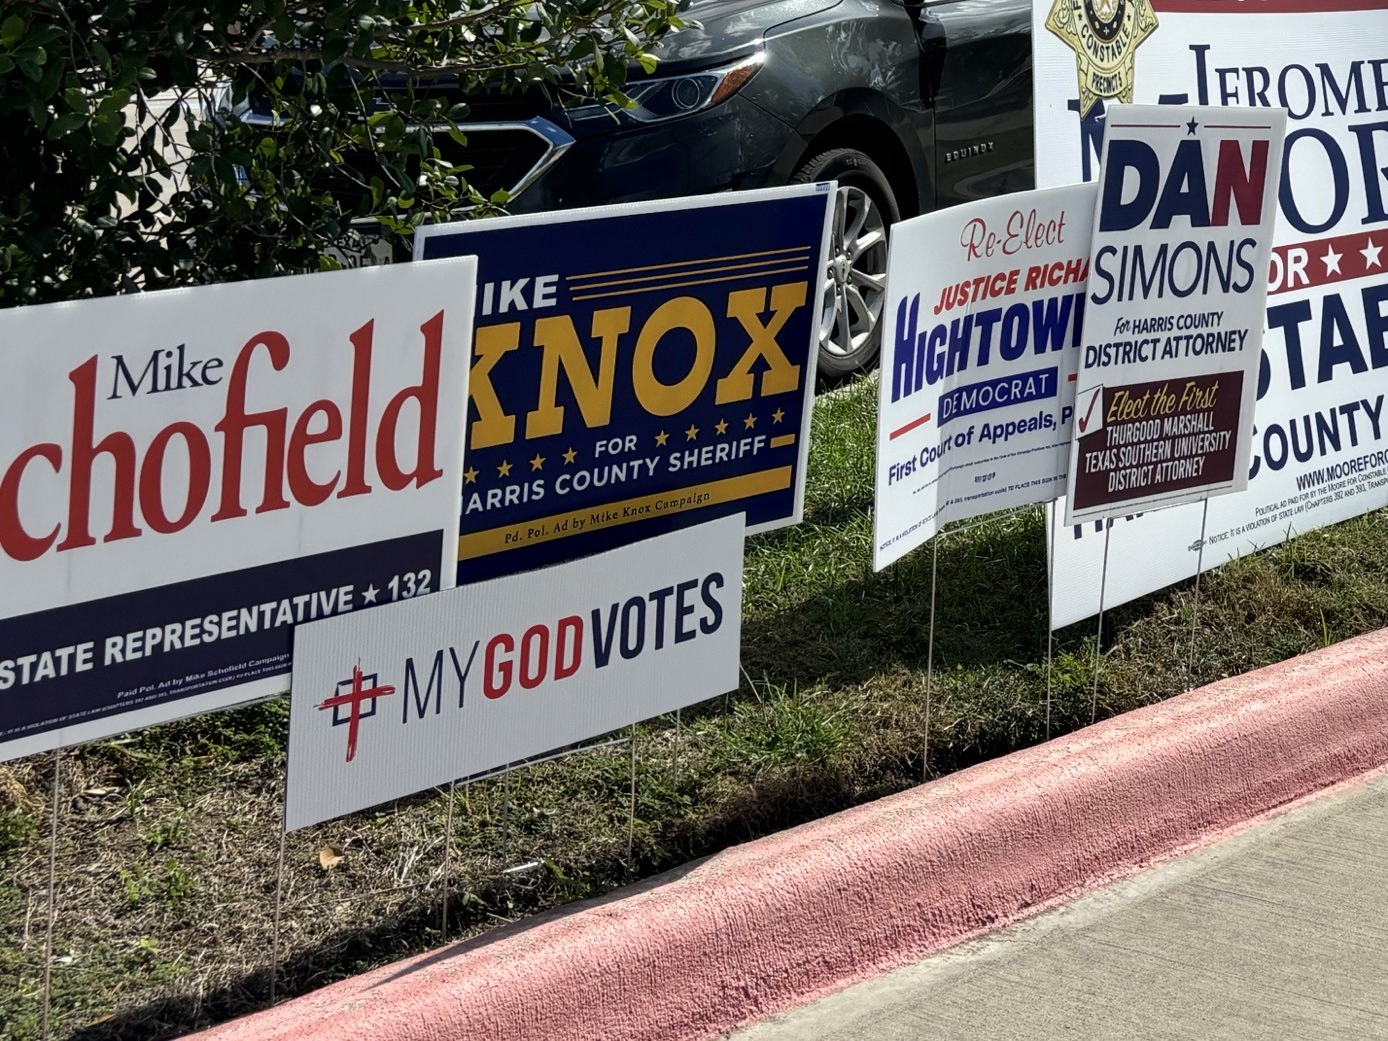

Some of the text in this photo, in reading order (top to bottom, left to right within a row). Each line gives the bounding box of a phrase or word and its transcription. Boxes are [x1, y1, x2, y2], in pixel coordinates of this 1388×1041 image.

[1080, 23, 1131, 64] CONSTABLE
[1091, 71, 1118, 93] PRECINCT
[945, 141, 994, 162] EQUINOX
[1099, 138, 1270, 233] DAN
[960, 208, 1066, 262] Re-Elect
[933, 257, 1090, 315] JUSTICE RICHA
[1090, 237, 1256, 306] SIMONS
[1267, 245, 1310, 293] OR
[474, 274, 559, 316] IKE
[1113, 311, 1224, 337] For HARRIS COUNTY
[891, 292, 1087, 403] HIGHTOW
[1084, 329, 1249, 369] DISTRICT ATTORNEY
[107, 344, 224, 401] Mike
[943, 373, 1050, 419] DEMOCRAT
[1107, 388, 1150, 422] Elect
[1150, 383, 1177, 416] the
[1178, 380, 1220, 413] First
[595, 434, 638, 458] FOR
[888, 457, 918, 486] First
[919, 434, 952, 468] Court
[954, 425, 975, 447] of
[978, 410, 1057, 445] Appeals,
[1085, 449, 1117, 473] TEXAS
[1118, 439, 1172, 469] SOUTHERN
[1174, 430, 1232, 459] UNIVERSITY
[1106, 412, 1215, 447] THURGOOD MARSHALL
[461, 434, 767, 517] ARRIS COUNTY SHERIFF
[1108, 456, 1206, 493] DISTRICT ATTORNEY
[504, 490, 711, 544] Pd. Pol. Ad by Mike Knox Campaign
[0, 568, 432, 690] STATE REPRESENTATIVE 132
[400, 572, 726, 726] MYGODVOTES
[117, 653, 290, 699] Paid Pol. Ad by Mike Schofield Campaign
